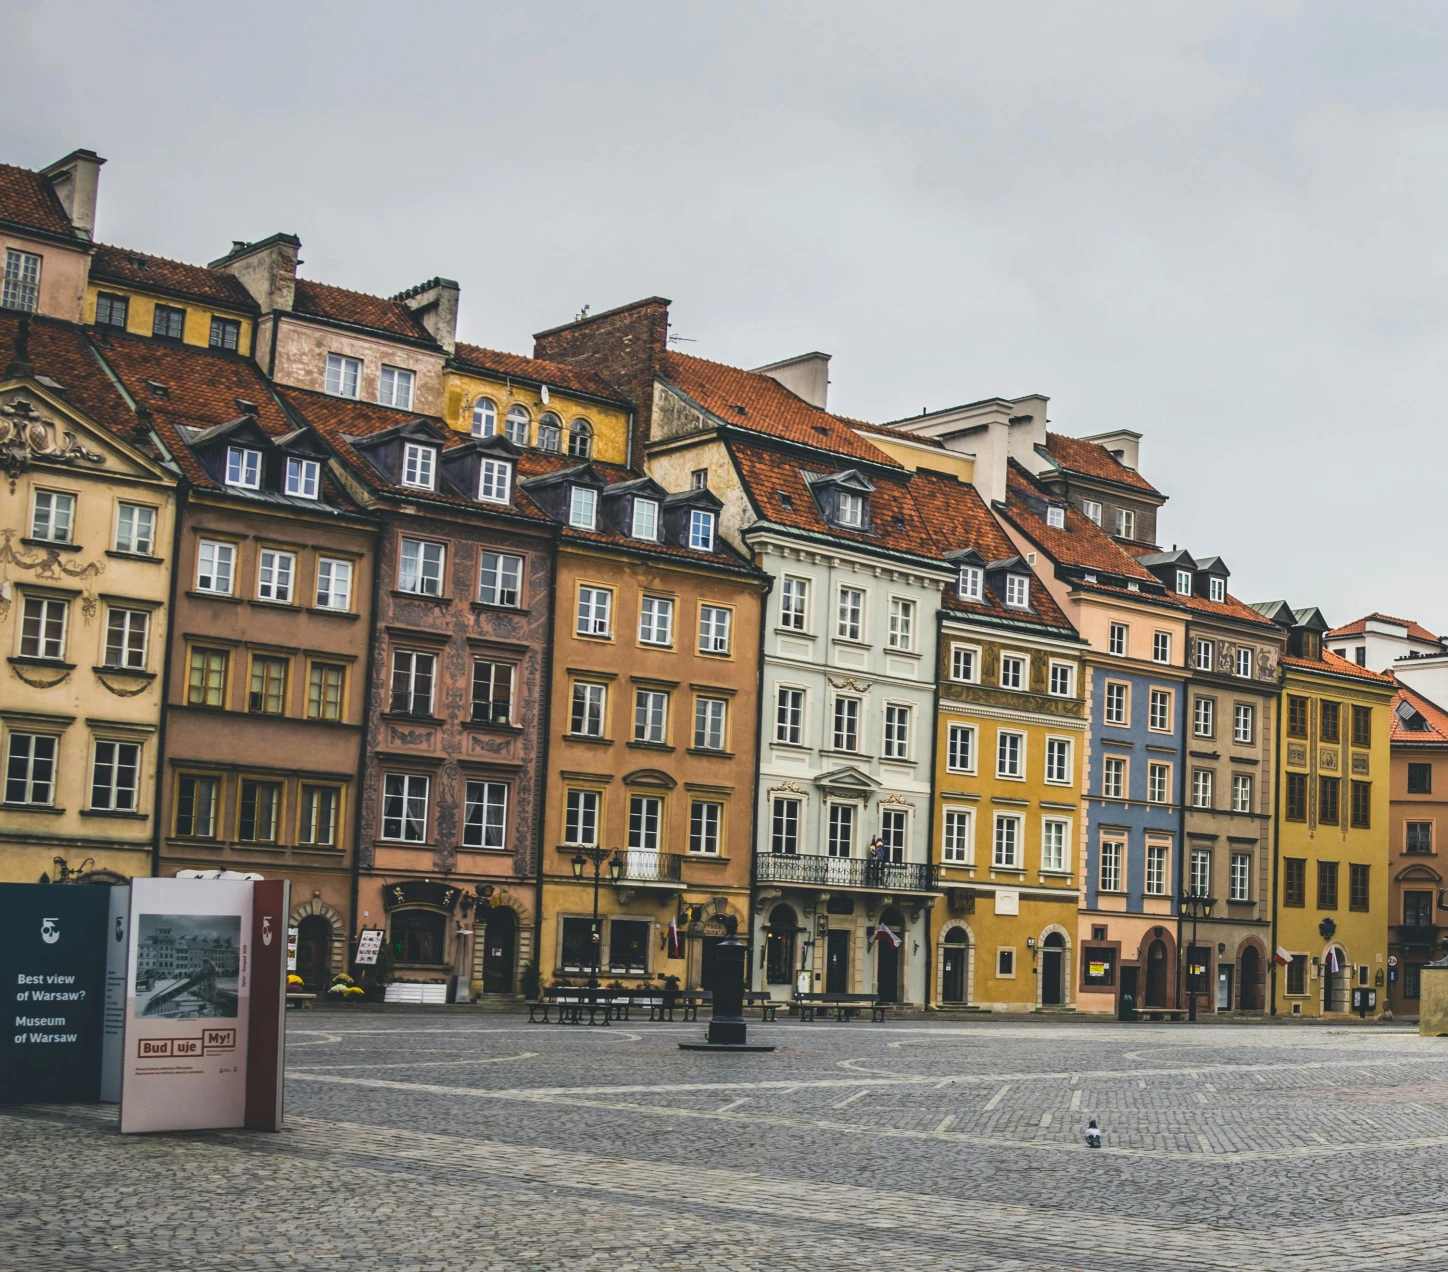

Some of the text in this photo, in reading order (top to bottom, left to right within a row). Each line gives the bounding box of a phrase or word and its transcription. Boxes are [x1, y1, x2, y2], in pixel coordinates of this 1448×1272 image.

[17, 974, 75, 985] Best view
[16, 990, 86, 1001] of Warsaw?
[15, 1016, 66, 1026] Museum
[14, 1032, 78, 1043] of Warsaw
[143, 1032, 231, 1054] Bud uje My!
